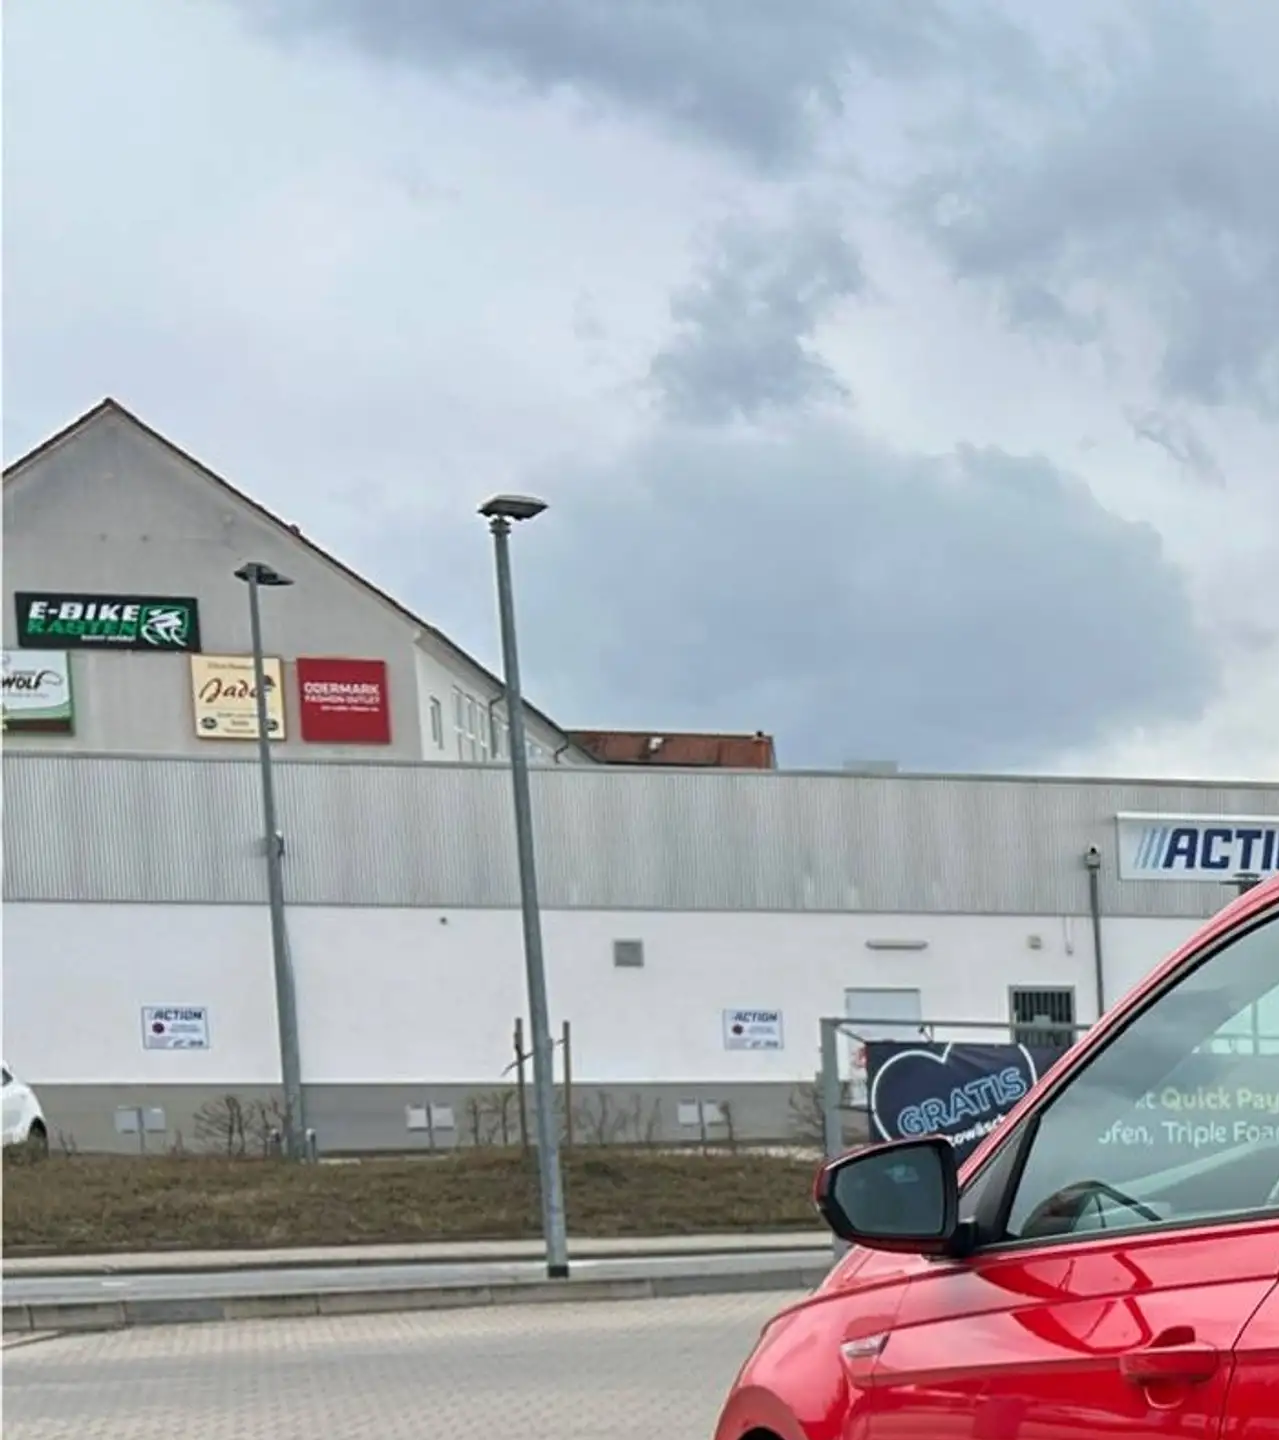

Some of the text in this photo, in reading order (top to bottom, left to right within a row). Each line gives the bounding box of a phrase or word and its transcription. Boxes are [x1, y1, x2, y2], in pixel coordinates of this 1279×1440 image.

[29, 601, 140, 621] E-BIKE
[897, 1066, 1027, 1137] GRATIS
[1161, 1086, 1231, 1110] Quick
[1161, 1122, 1227, 1148] Triple
